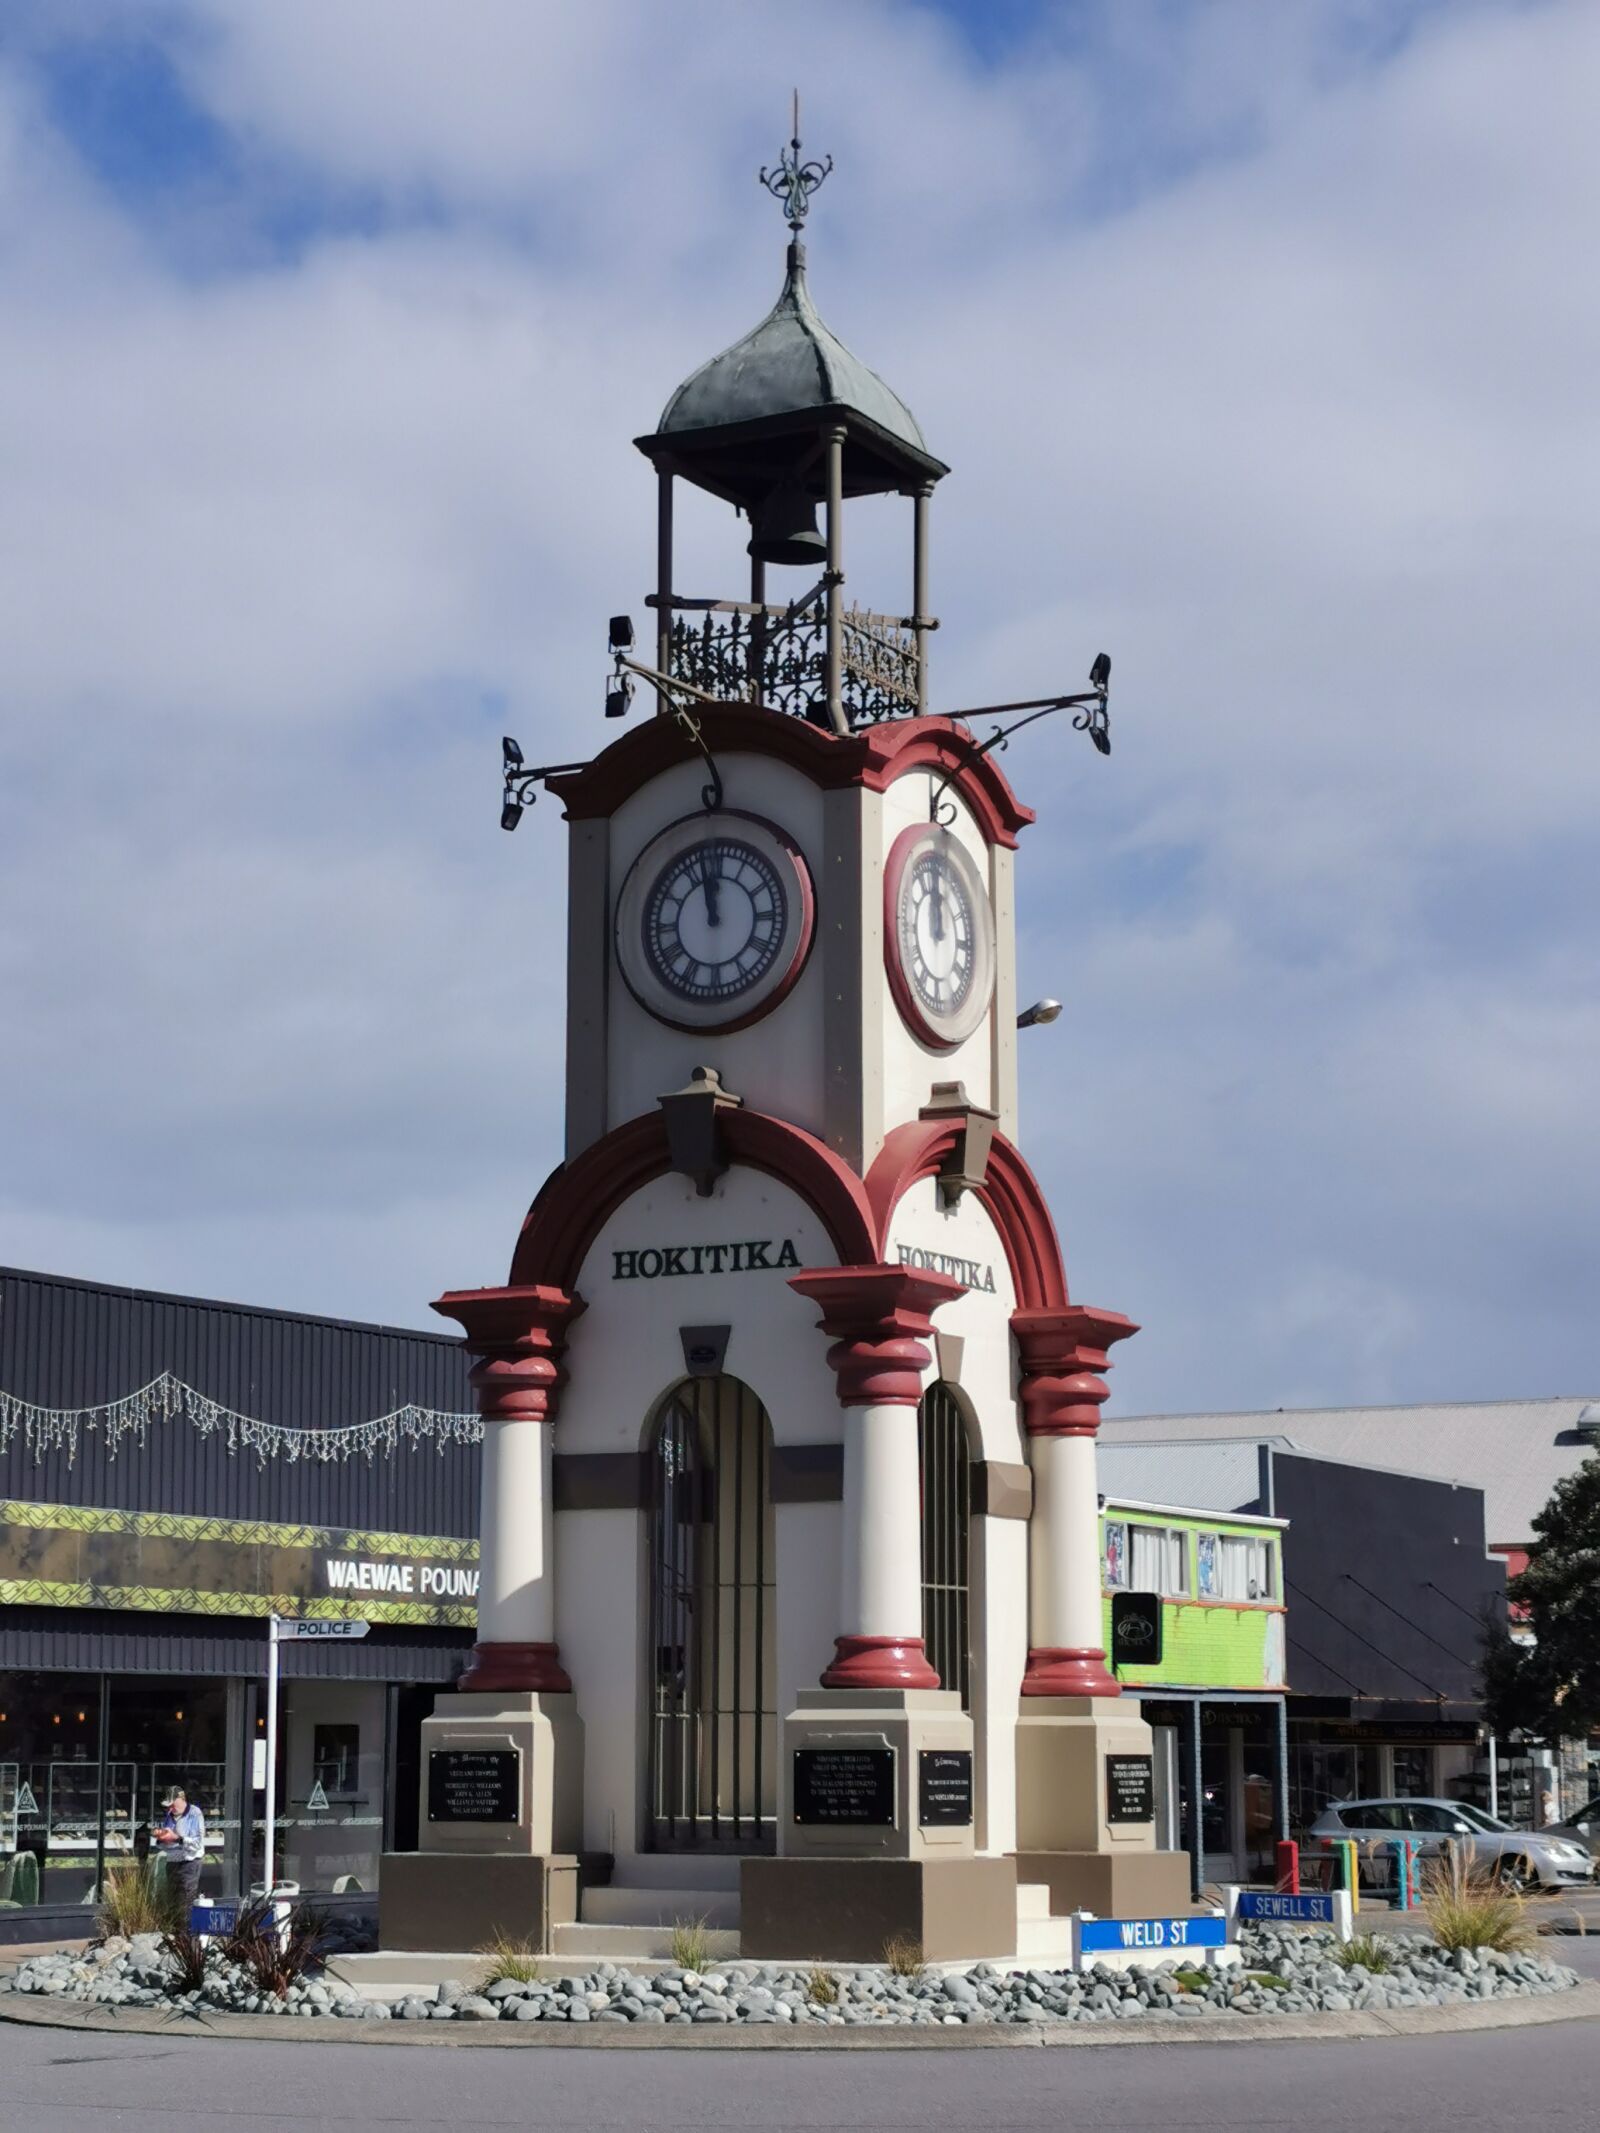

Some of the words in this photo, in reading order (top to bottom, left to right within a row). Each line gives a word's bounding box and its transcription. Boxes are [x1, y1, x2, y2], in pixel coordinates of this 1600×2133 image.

[612, 1238, 804, 1281] HOKITIKA
[896, 1243, 997, 1294] HOKITIKA
[326, 1559, 414, 1593] WAEWAE
[297, 1622, 352, 1636] POLICE
[1255, 1896, 1306, 1918] SEWELL
[1309, 1898, 1326, 1918] ST
[1121, 1922, 1164, 1946] WELD
[1170, 1920, 1189, 1945] ST
